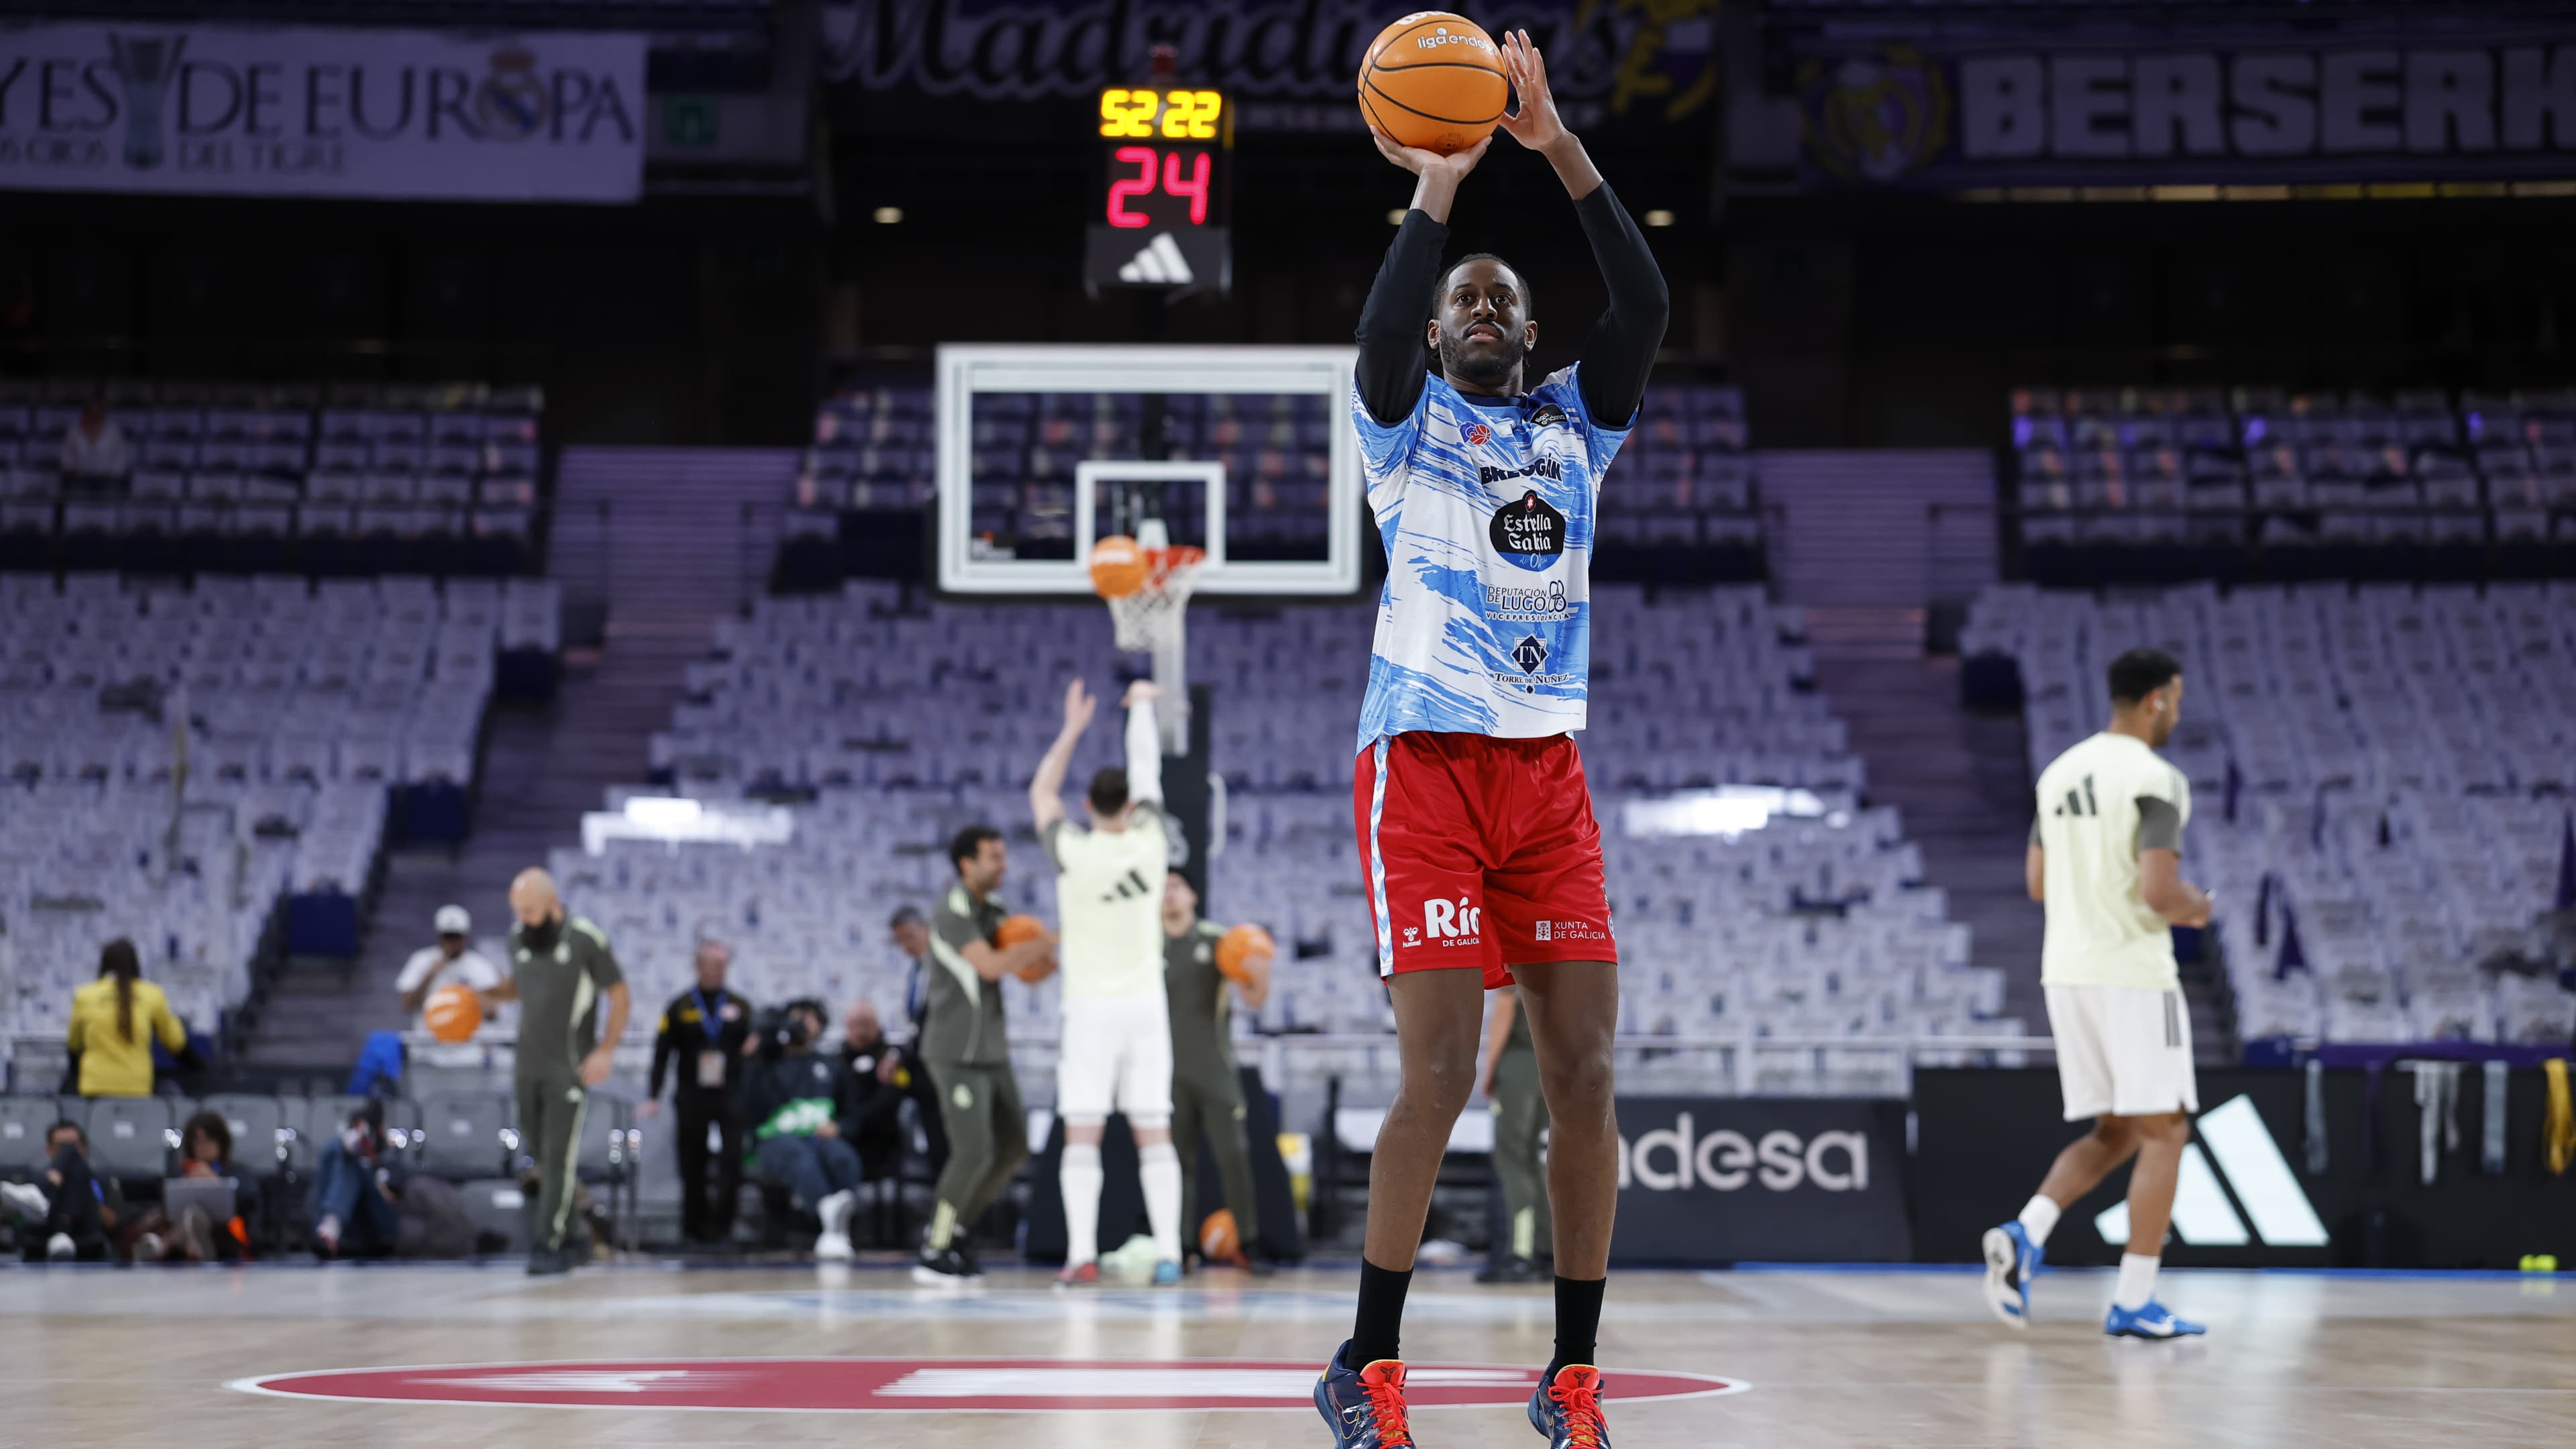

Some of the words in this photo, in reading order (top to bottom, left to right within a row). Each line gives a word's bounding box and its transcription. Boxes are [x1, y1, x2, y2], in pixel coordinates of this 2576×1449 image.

[1417, 36, 1447, 49] liga
[177, 63, 283, 136] DE
[1107, 146, 1211, 228] 24
[1488, 586, 1547, 597] DEPUTACIÓN
[1487, 594, 1500, 602] DE
[1502, 595, 1546, 611] LUGO
[1486, 612, 1569, 621] VICEPRESIDENCIA
[1516, 646, 1542, 663] TN
[1554, 921, 1589, 930] XUNTA
[1554, 930, 1566, 939] DE
[1570, 930, 1606, 940] GALICIA
[1617, 1112, 1869, 1191] desa
